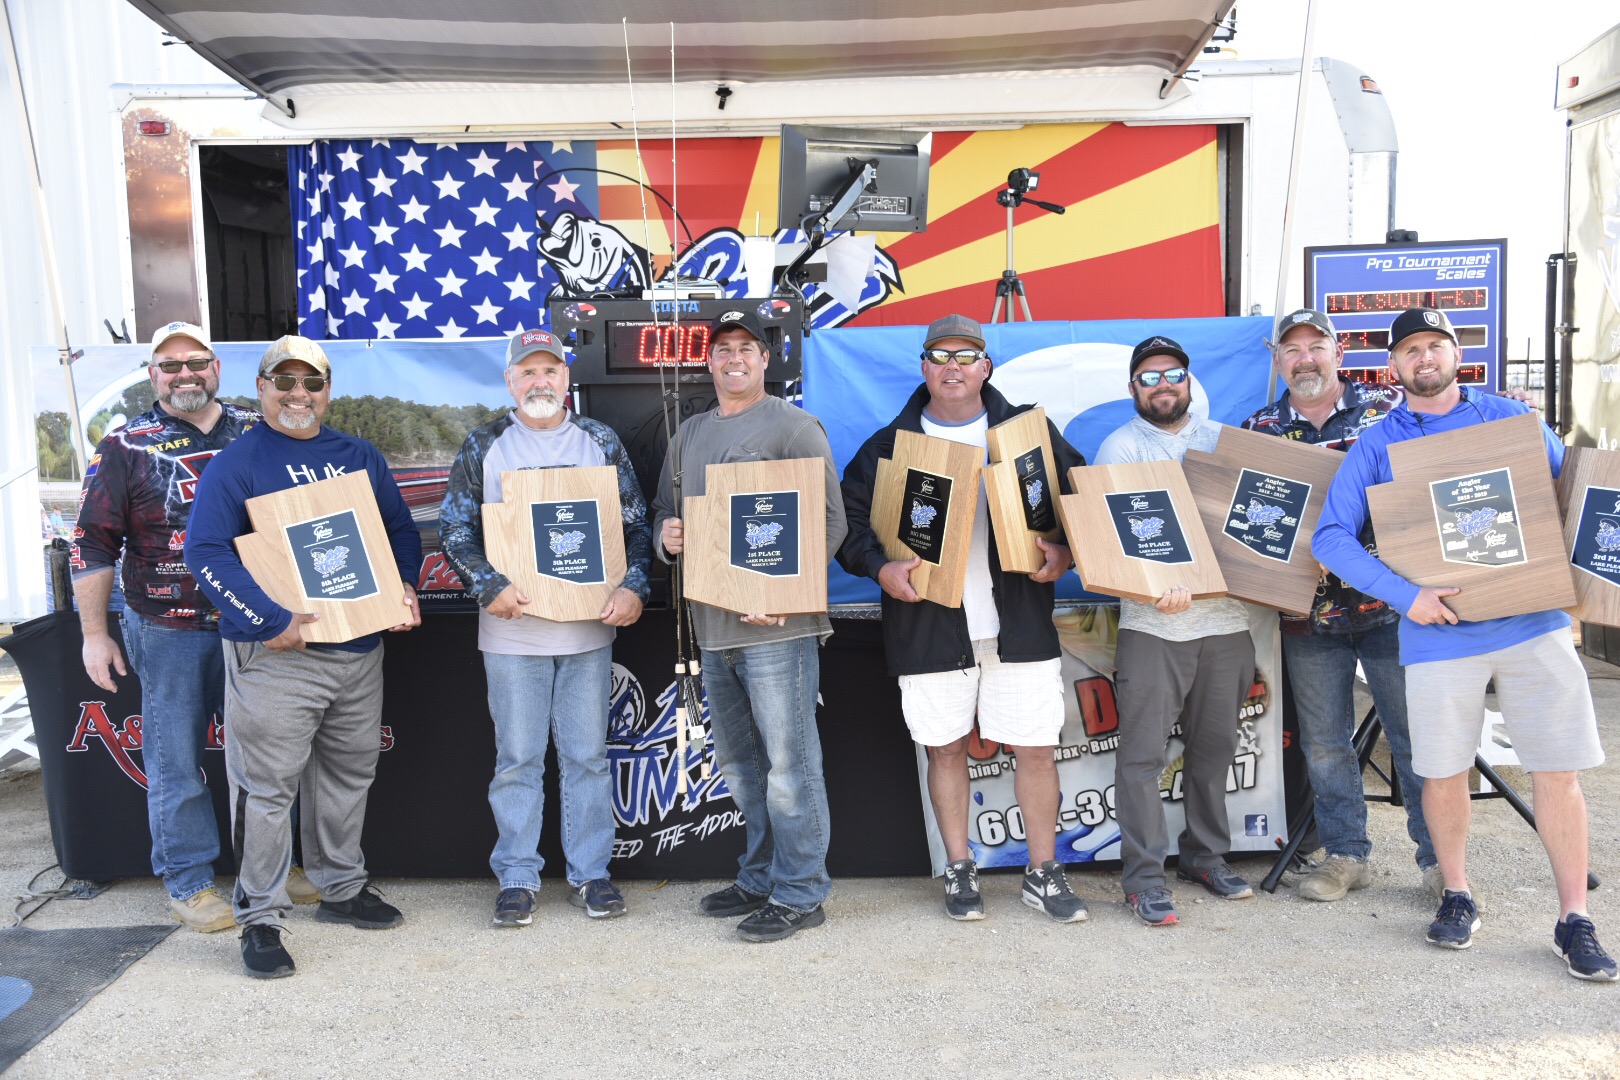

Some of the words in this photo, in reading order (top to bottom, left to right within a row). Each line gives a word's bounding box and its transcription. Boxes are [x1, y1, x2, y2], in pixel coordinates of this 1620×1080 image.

[1366, 257, 1392, 270] Pro
[1399, 253, 1491, 268] Tournament
[1436, 267, 1486, 280] Scales
[651, 301, 699, 312] COSTA
[1281, 430, 1302, 440] AFF
[146, 438, 191, 454] STAFF
[286, 463, 346, 483] Huk
[1264, 478, 1286, 486] Angler
[1458, 478, 1482, 488] Angler
[333, 572, 356, 584] PLACE
[200, 566, 224, 592] Huk
[224, 590, 264, 626] Fishing
[968, 762, 1000, 780] hing
[1090, 736, 1120, 754] Buff
[612, 838, 644, 859] EED
[651, 822, 694, 856] THE
[690, 810, 746, 841] ADDIC
